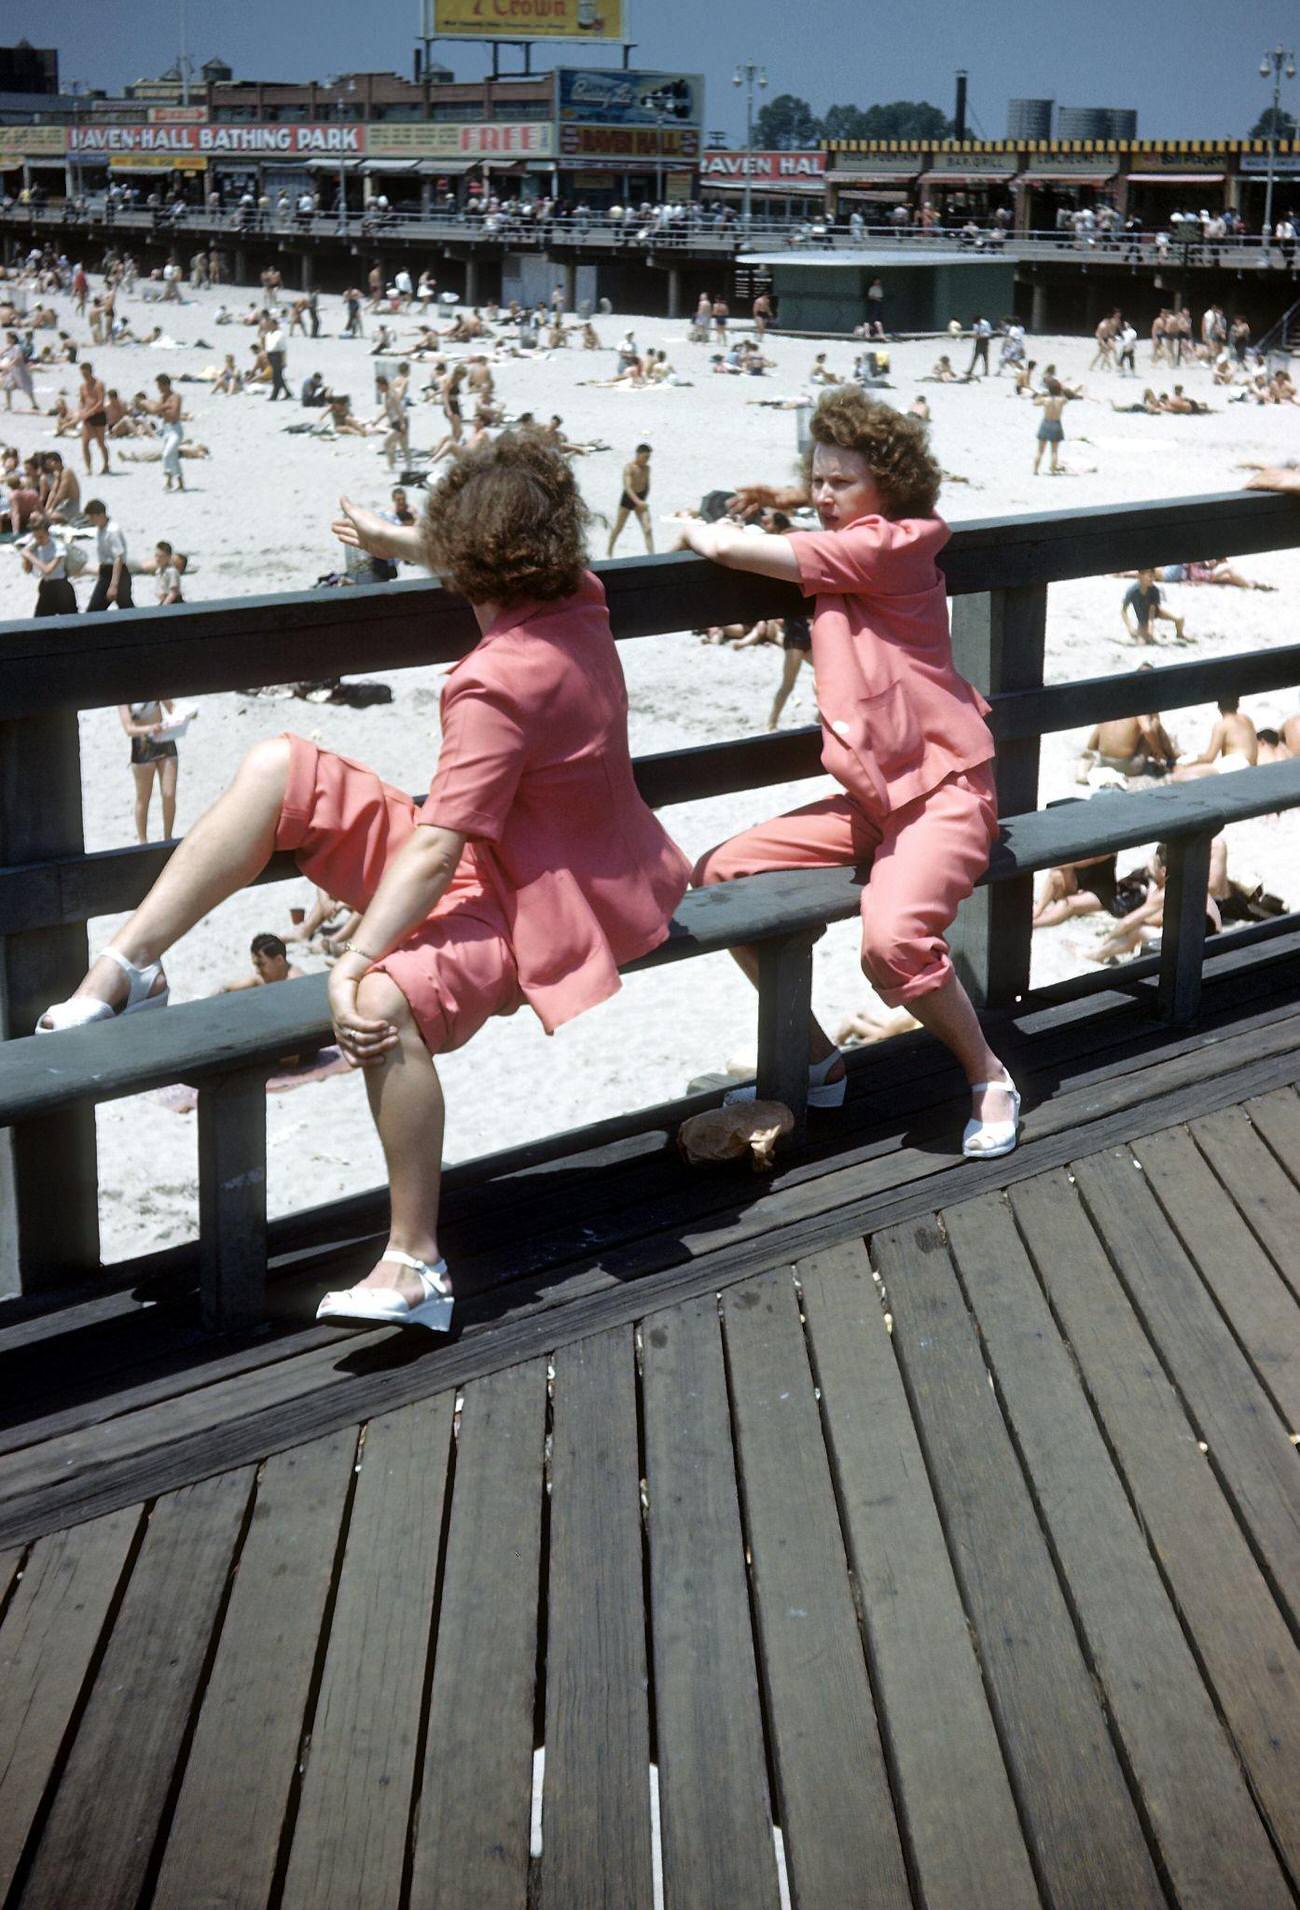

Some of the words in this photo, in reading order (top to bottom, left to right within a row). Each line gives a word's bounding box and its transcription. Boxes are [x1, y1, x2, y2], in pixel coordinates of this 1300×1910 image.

[494, 0, 566, 16] Crown
[199, 127, 292, 149] BATHING
[298, 127, 358, 149] PARK
[461, 126, 538, 150] FREE
